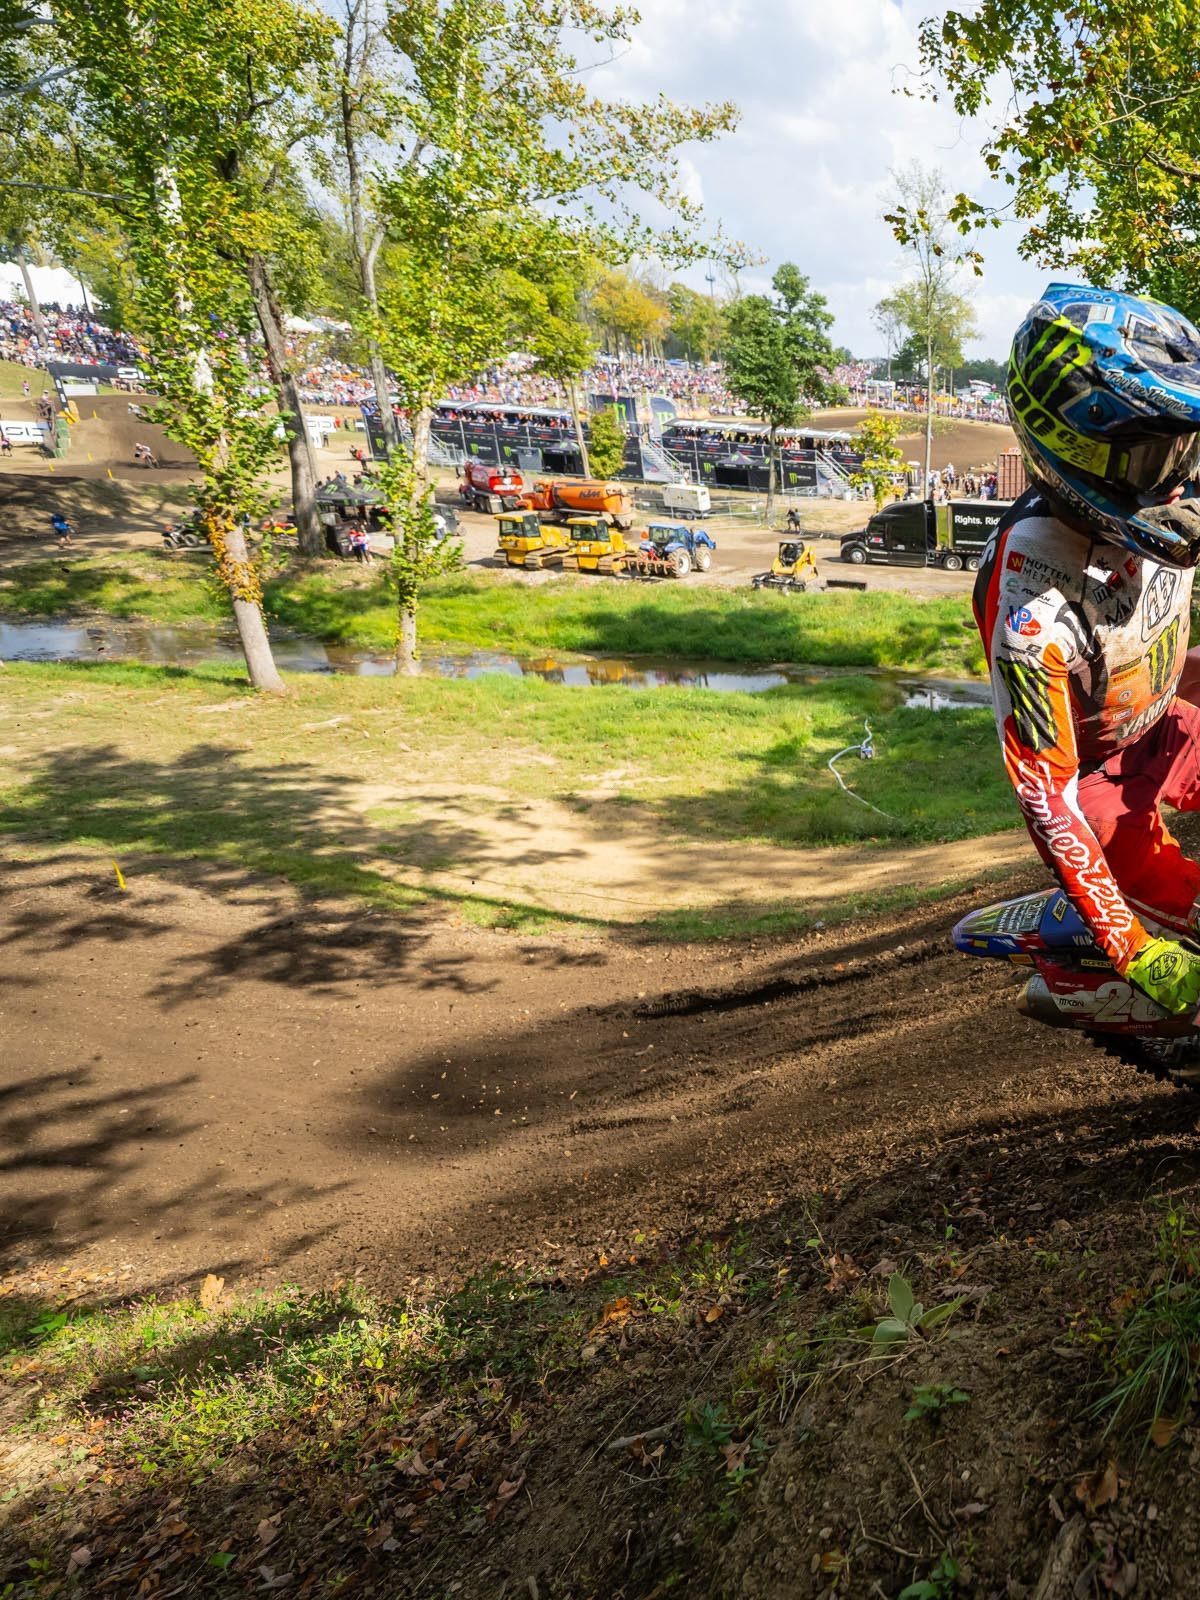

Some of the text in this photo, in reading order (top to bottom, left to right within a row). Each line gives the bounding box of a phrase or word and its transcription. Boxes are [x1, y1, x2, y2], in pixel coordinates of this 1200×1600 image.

[1103, 368, 1193, 414] Troy Lee Designs
[954, 515, 982, 525] Rights.
[1025, 558, 1071, 583] HUTTEN
[1009, 605, 1032, 633] VP
[1122, 671, 1181, 738] YAMAHA
